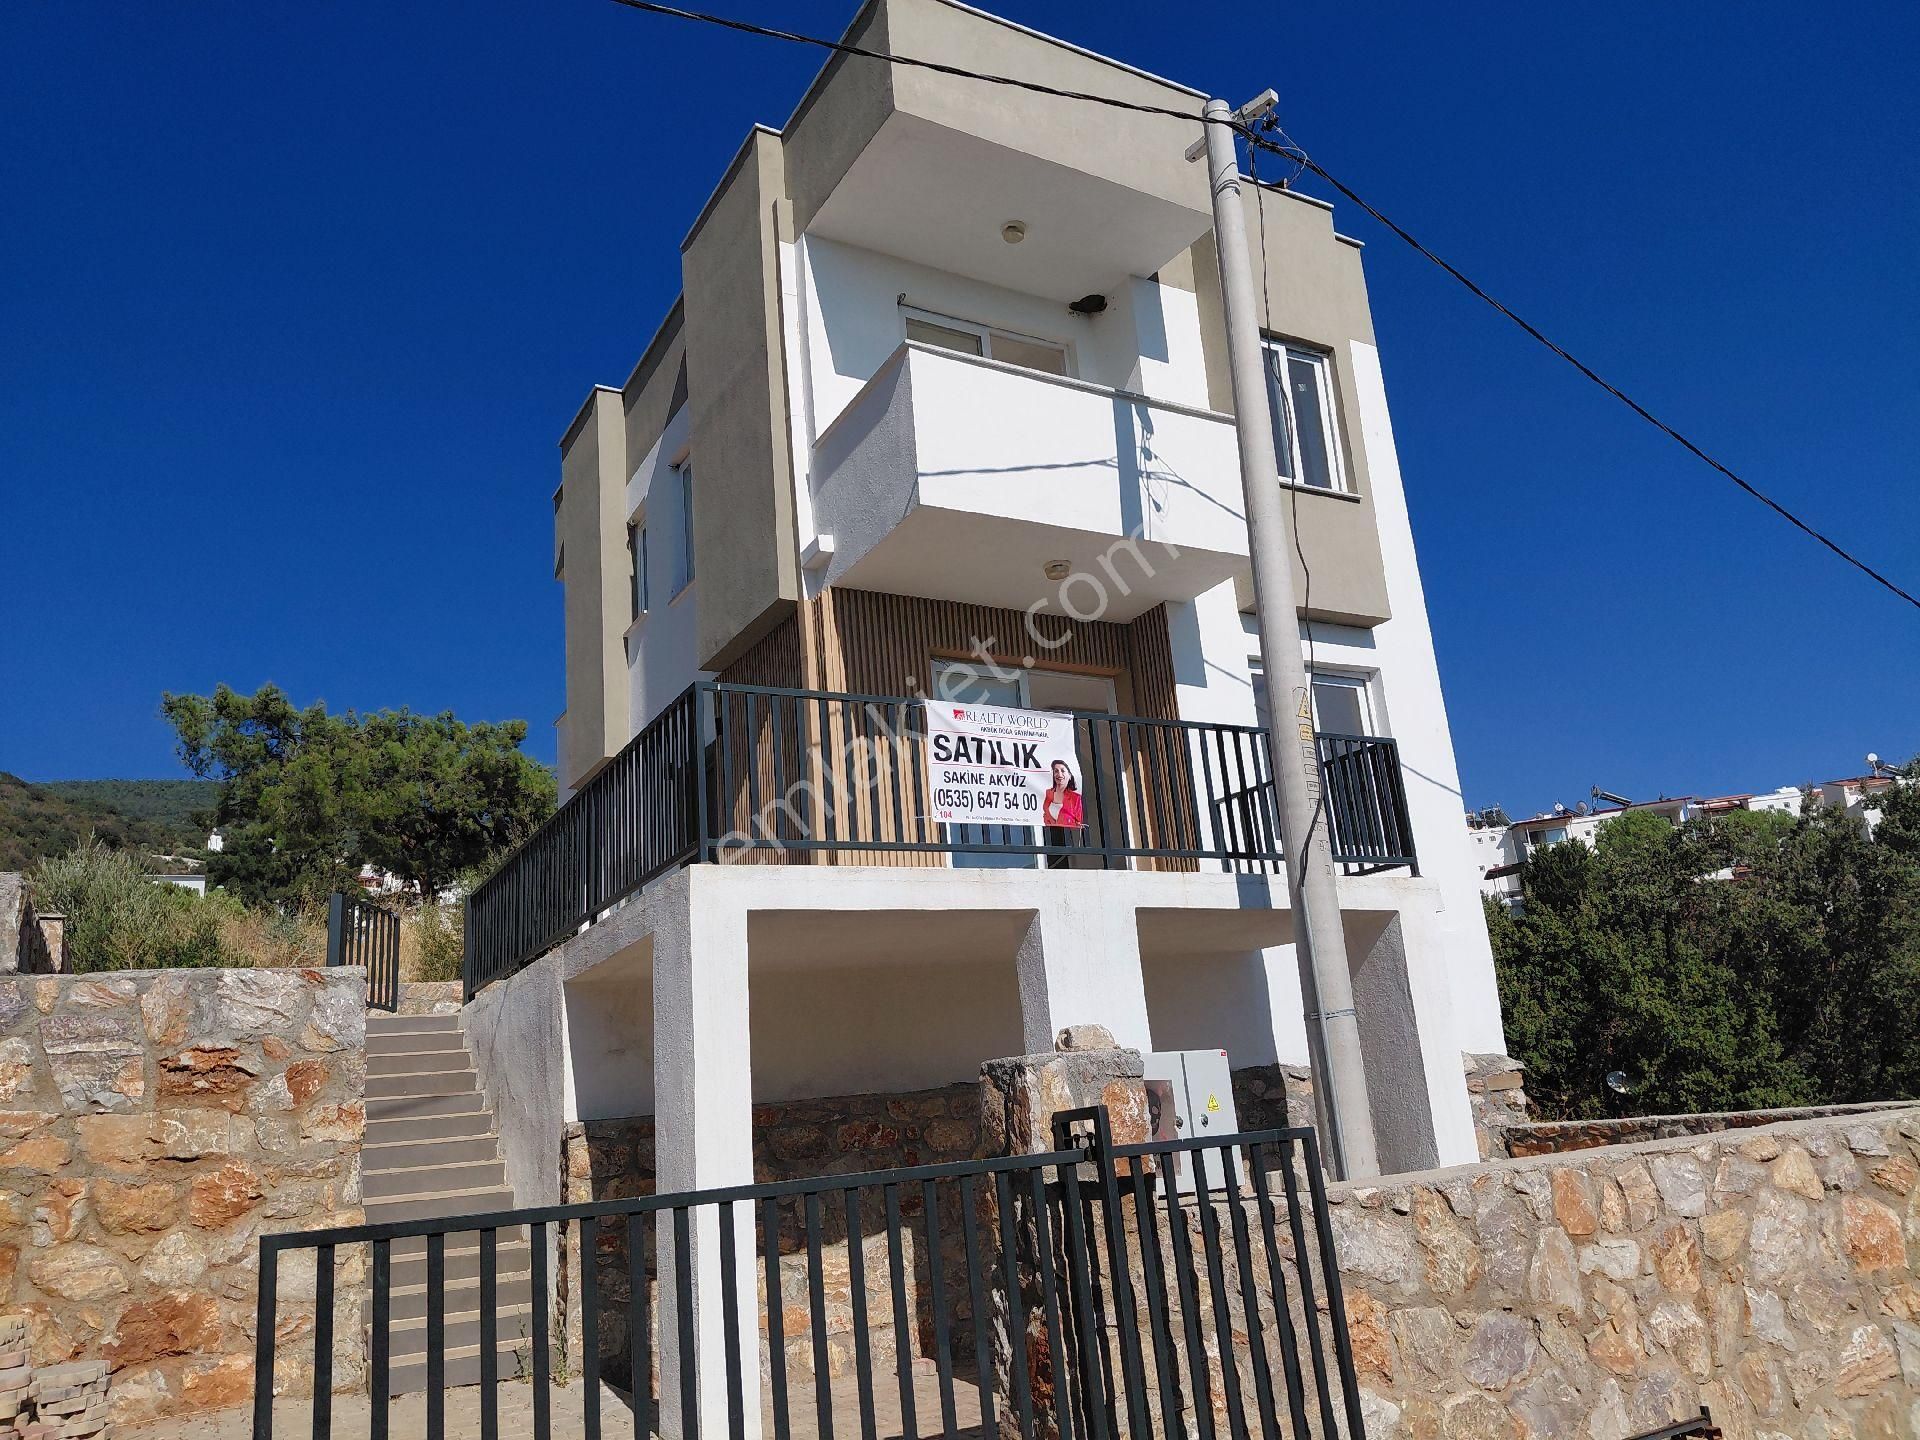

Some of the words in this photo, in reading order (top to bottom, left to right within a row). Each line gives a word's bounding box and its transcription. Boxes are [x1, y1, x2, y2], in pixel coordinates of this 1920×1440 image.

[966, 711, 1004, 724] REALTY
[1008, 714, 1048, 729] WORLD
[933, 734, 1041, 768] SATILIK
[943, 770, 985, 785] SAKİNE
[989, 772, 1026, 788] AKYÜZ
[934, 788, 973, 812] (0535)
[977, 791, 999, 809] 647
[1003, 792, 1019, 810] 54
[1023, 793, 1038, 811] 00
[939, 811, 952, 819] 104
